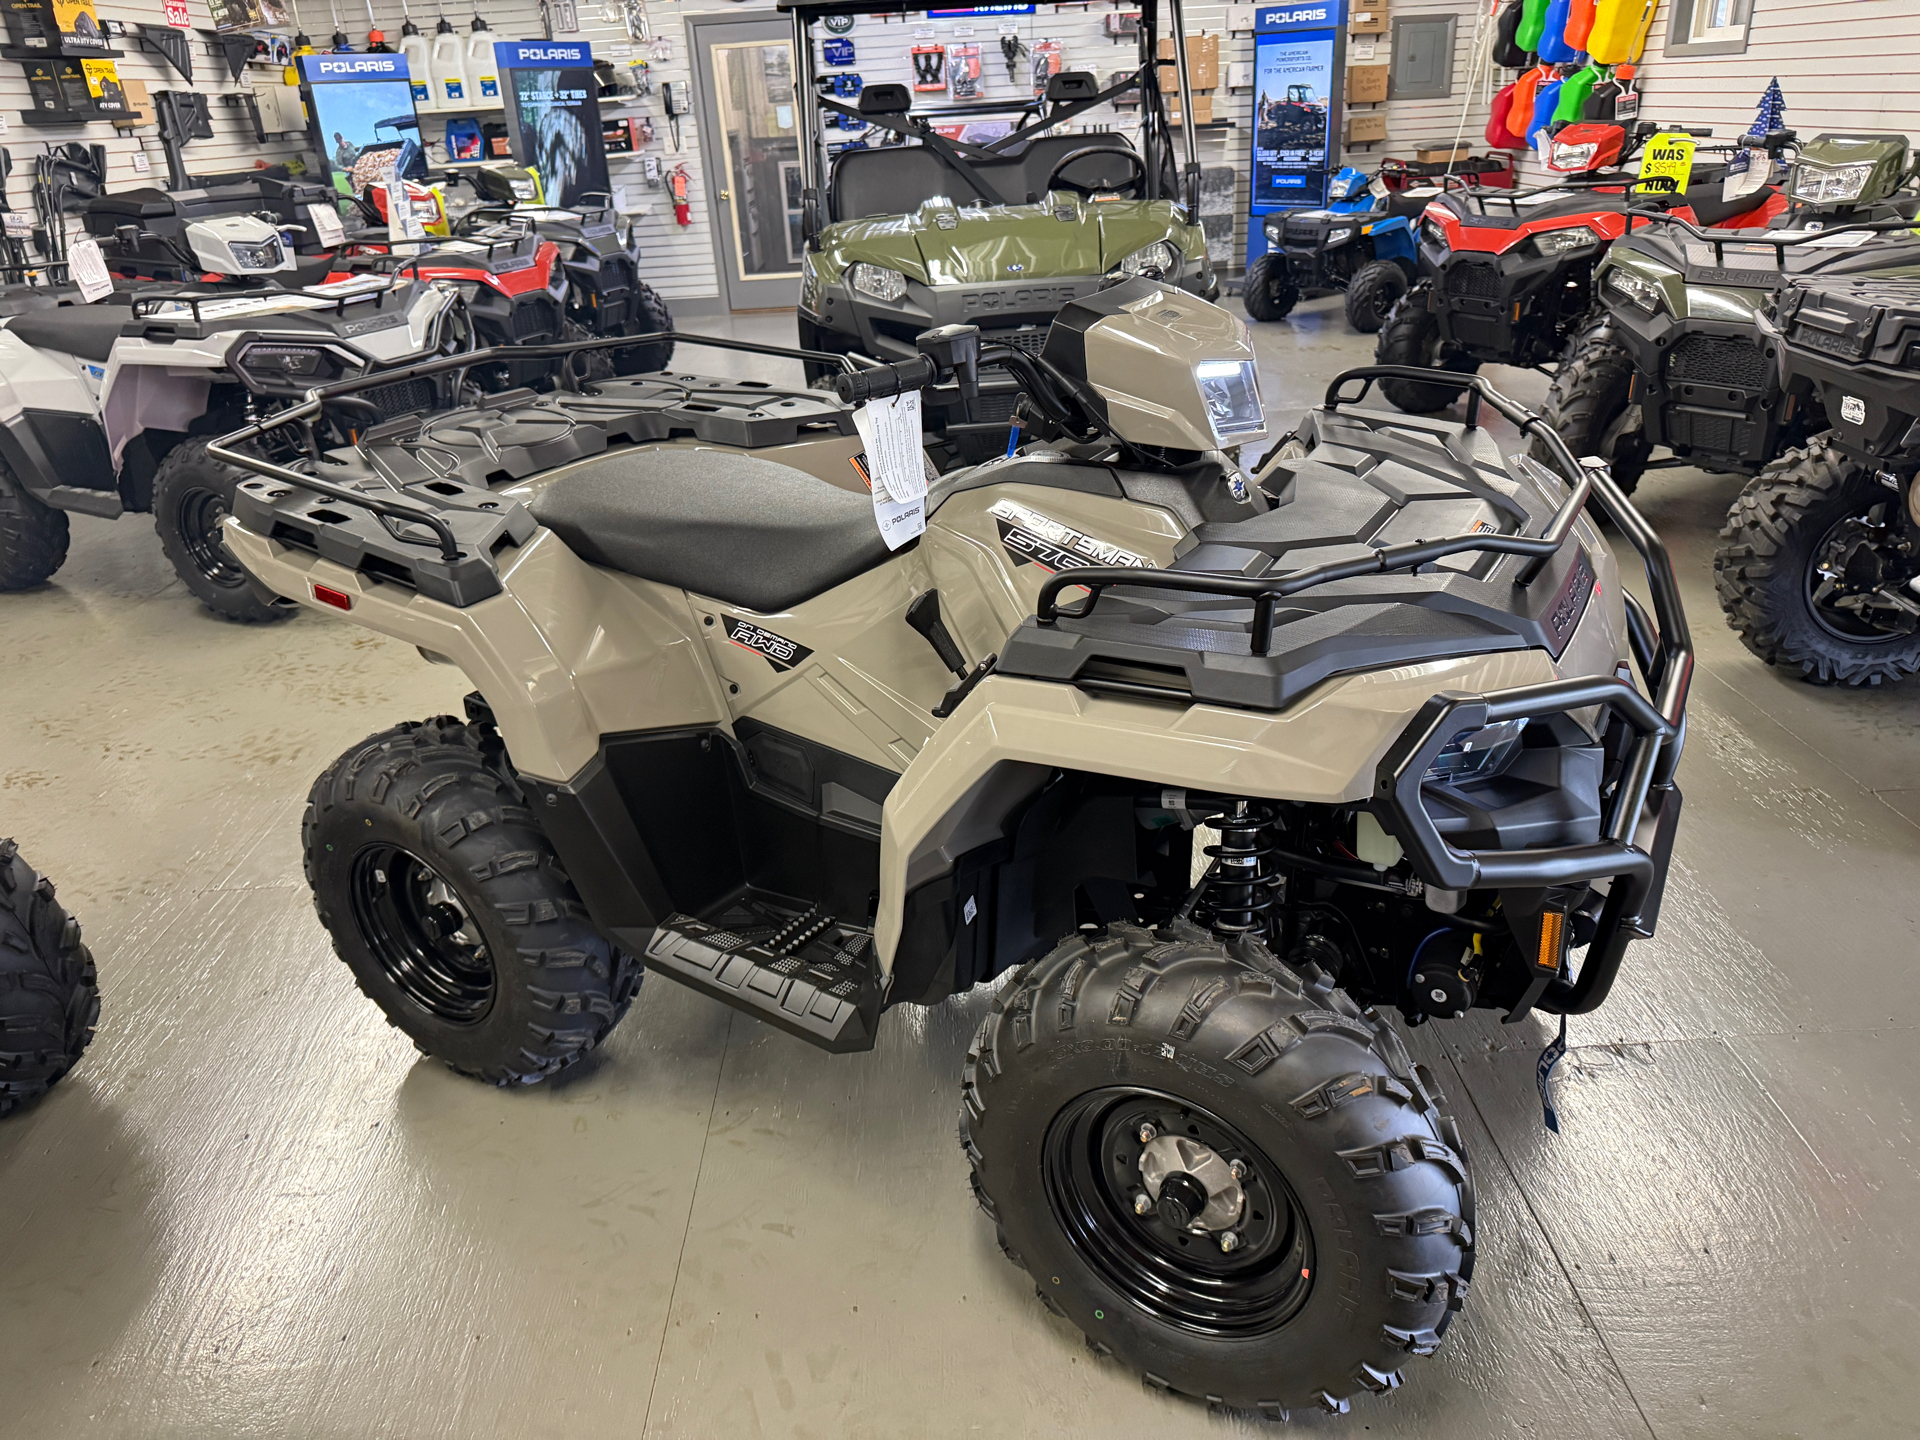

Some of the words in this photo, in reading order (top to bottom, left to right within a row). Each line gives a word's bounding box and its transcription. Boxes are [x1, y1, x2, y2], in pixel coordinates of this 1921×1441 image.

[167, 7, 188, 26] Sale
[830, 18, 848, 26] VIP
[1265, 8, 1326, 25] POLARIS
[64, 36, 80, 44] ULTRA
[90, 37, 103, 46] COVER
[518, 48, 581, 60] POLARIS
[832, 46, 854, 57] VIP
[320, 60, 395, 74] POLARIS
[530, 90, 554, 100] STANCE
[570, 90, 588, 100] TIRES
[1652, 148, 1685, 160] WAS
[1645, 163, 1652, 174] $
[494, 260, 530, 271] POLARIS
[1700, 270, 1780, 286] POLARIS
[962, 288, 1076, 312] POLARIS
[1800, 330, 1853, 356] POLARIS
[892, 506, 920, 526] POLARIS
[990, 501, 1160, 569] SPORTSMAN
[1551, 562, 1588, 639] POLARIS
[730, 627, 794, 660] AWD
